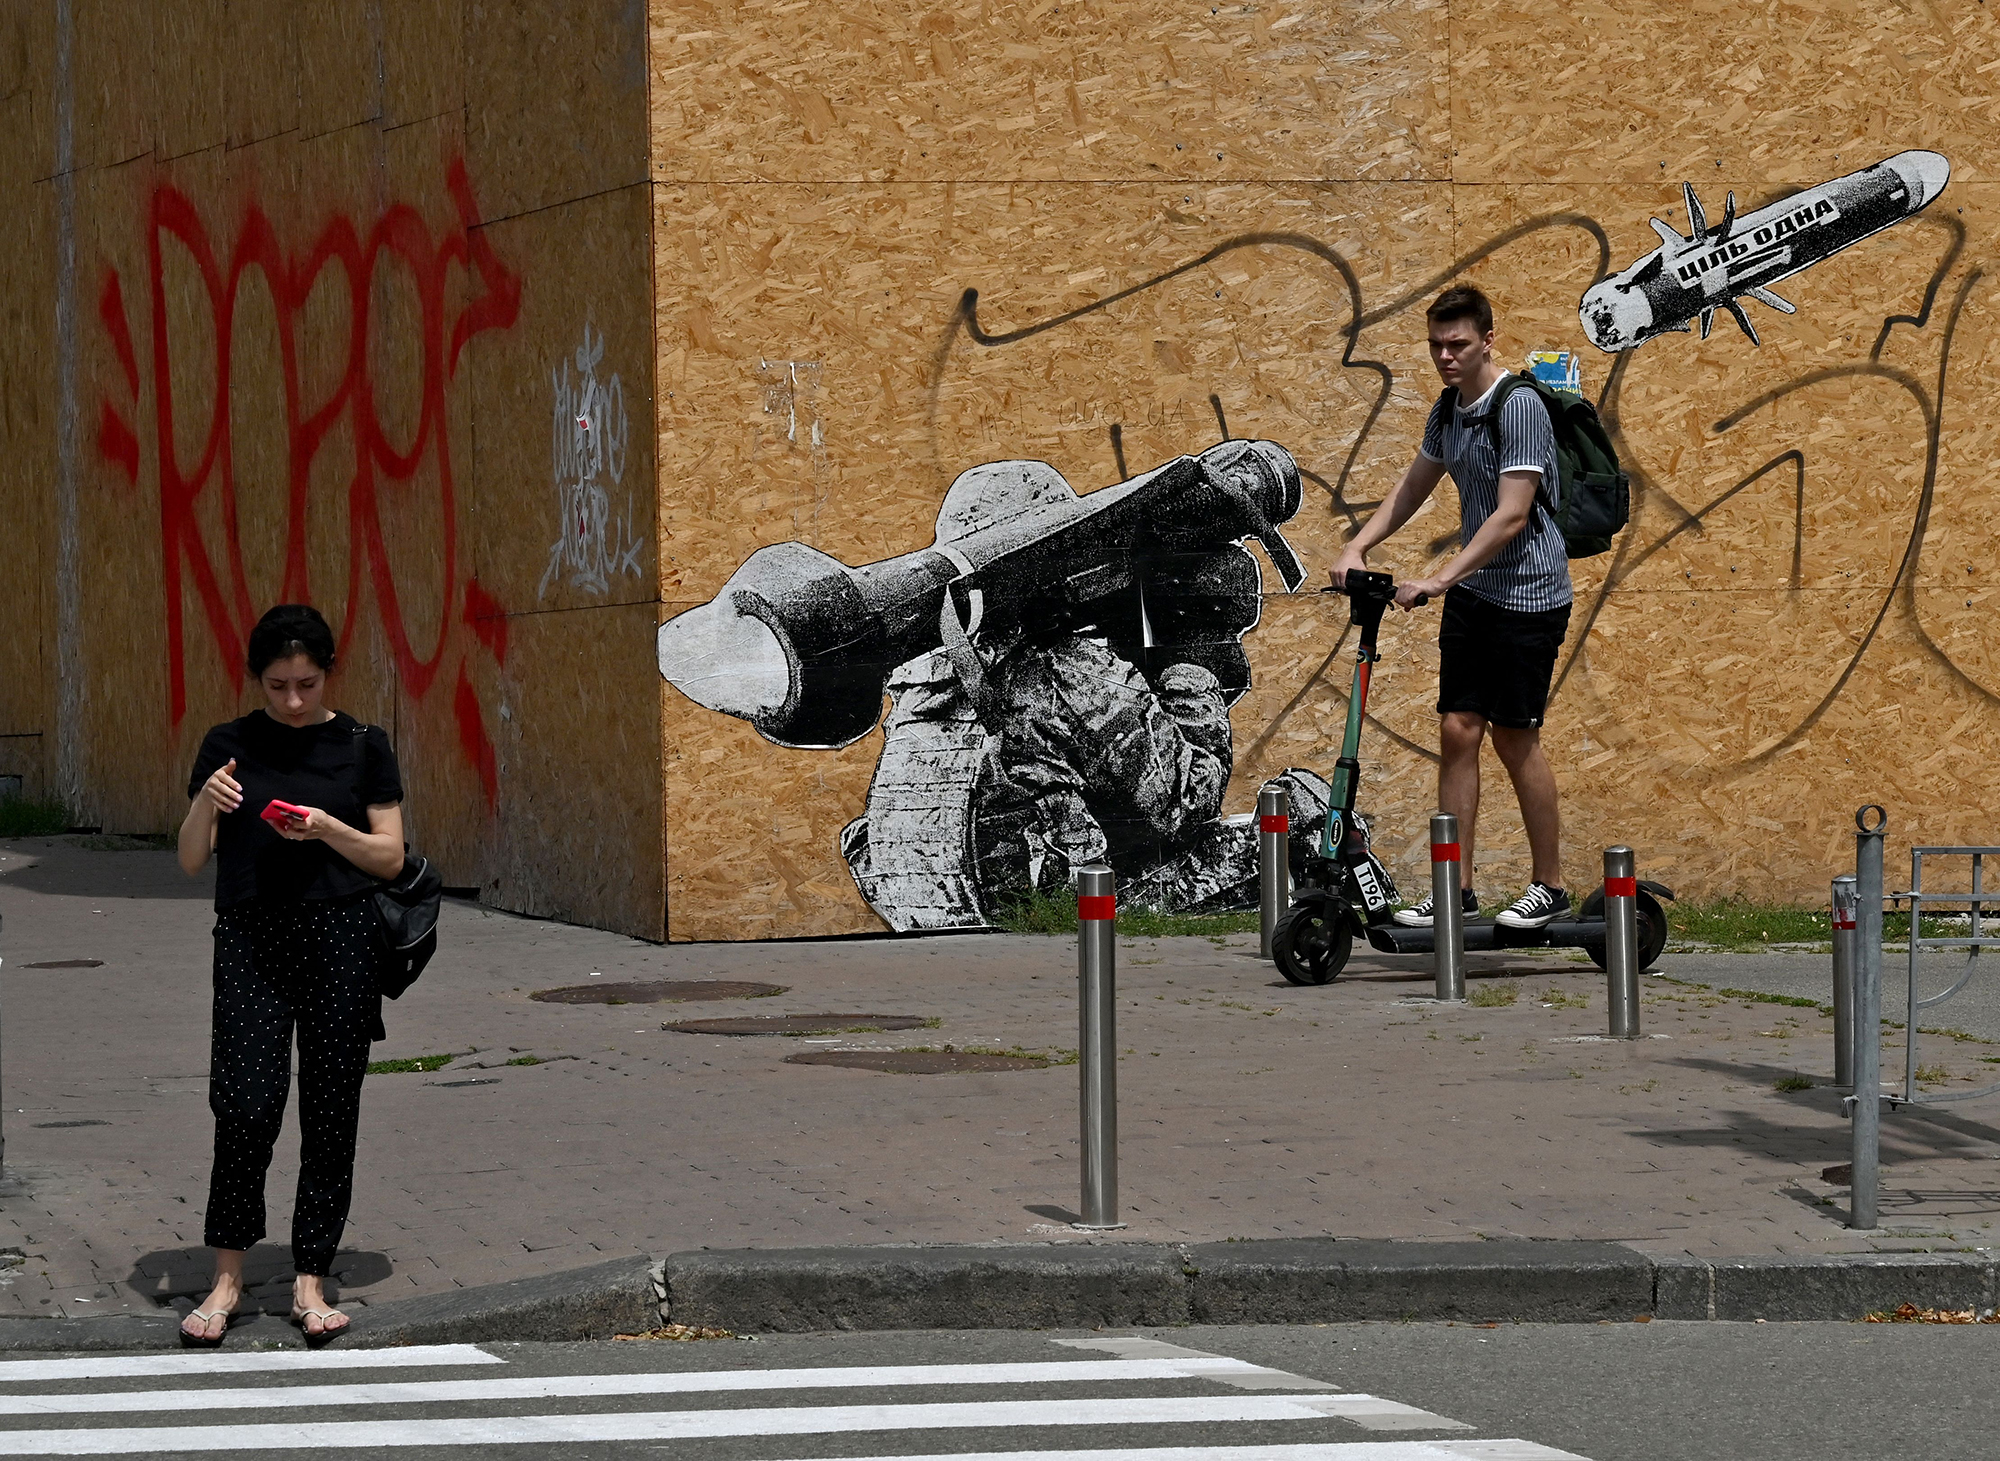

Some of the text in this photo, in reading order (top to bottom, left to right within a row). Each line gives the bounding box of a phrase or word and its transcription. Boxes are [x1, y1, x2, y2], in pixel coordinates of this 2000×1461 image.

[1677, 199, 1834, 282] ЦІЛЬ ОДНА
[1358, 867, 1382, 906] T196
